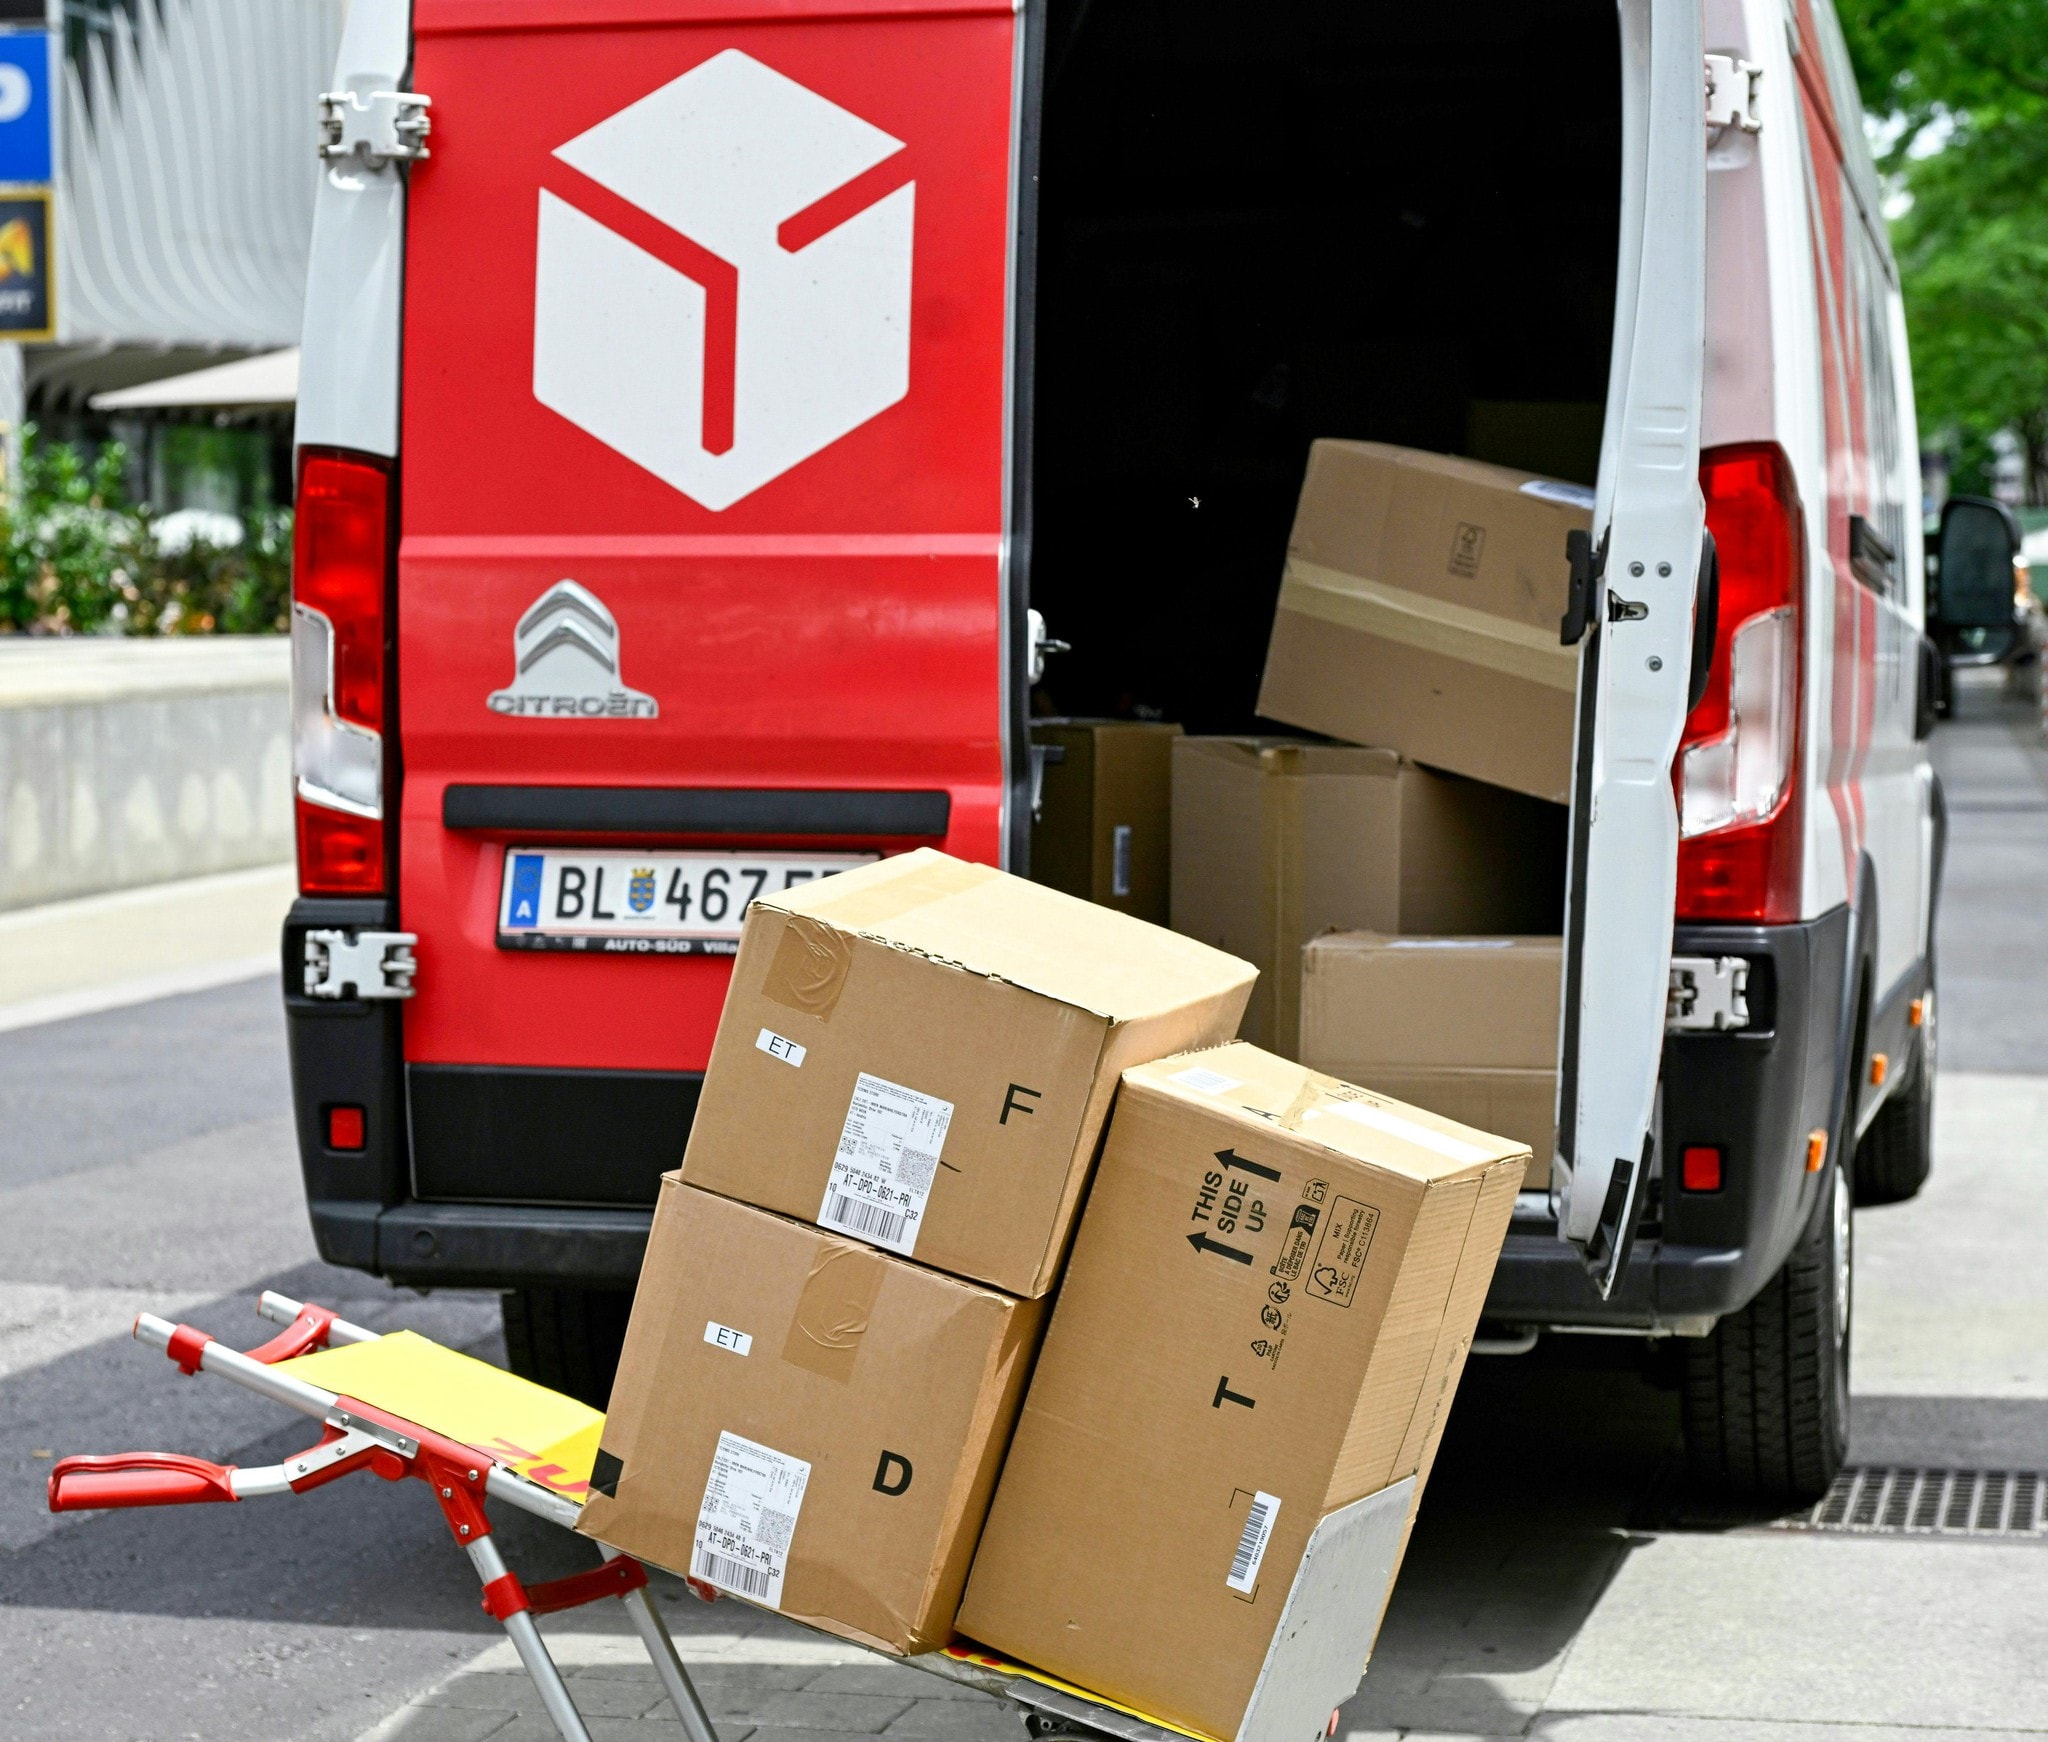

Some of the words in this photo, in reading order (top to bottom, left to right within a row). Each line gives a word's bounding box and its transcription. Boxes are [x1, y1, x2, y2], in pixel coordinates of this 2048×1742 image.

[555, 866, 615, 920] BL
[515, 900, 532, 918] A
[604, 938, 691, 953] AUTO-SÜD
[703, 941, 738, 954] Villa
[768, 1036, 797, 1059] ET
[999, 1082, 1042, 1125] F
[834, 1162, 849, 1172] 0629
[828, 1182, 838, 1192] 10
[1191, 1170, 1224, 1222] THIS
[904, 1208, 919, 1221] C32
[1217, 1179, 1249, 1234] SIDE
[1245, 1200, 1268, 1233] UP
[1332, 1223, 1343, 1238] MIX
[1336, 1242, 1347, 1260] Paper
[1343, 1208, 1359, 1238] Supporting
[1343, 1232, 1358, 1263] responsible
[1353, 1209, 1365, 1231] forestry
[1358, 1213, 1375, 1247] C113864
[1293, 1258, 1301, 1270] BAC
[1297, 1250, 1304, 1258] DE
[1335, 1272, 1350, 1295] FSC
[716, 1327, 743, 1349] ET
[1211, 1375, 1256, 1409] T
[871, 1449, 913, 1497] D
[698, 1520, 712, 1530] 0629
[767, 1567, 781, 1578] C32
